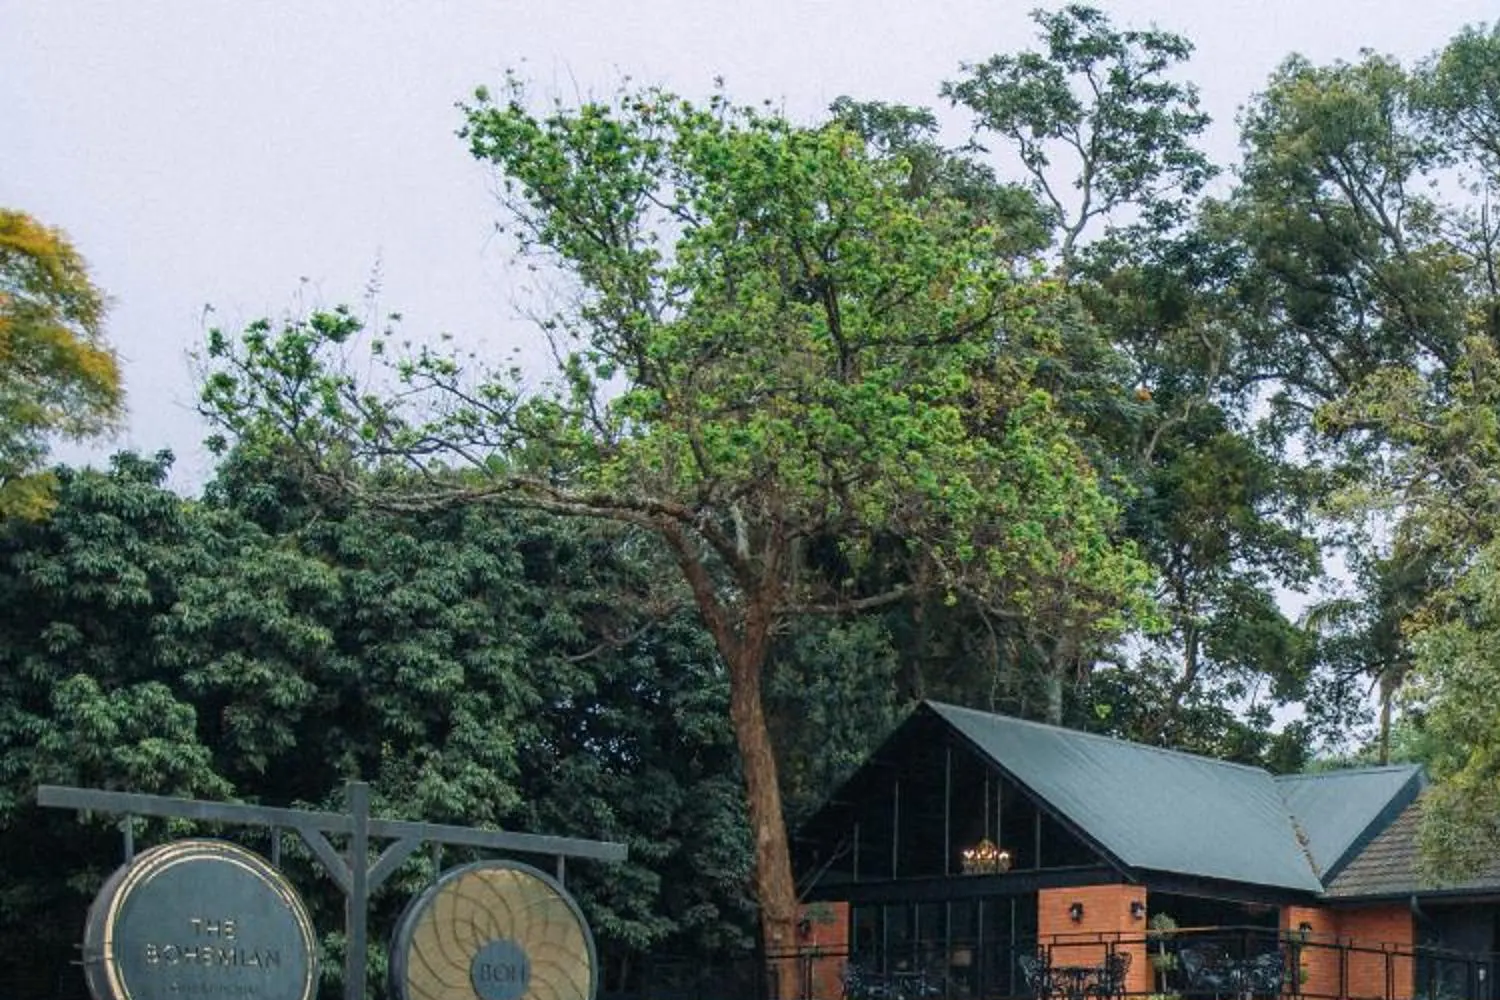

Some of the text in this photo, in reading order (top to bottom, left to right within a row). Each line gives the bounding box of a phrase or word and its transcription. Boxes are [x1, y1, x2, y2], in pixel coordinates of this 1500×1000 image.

[190, 918, 237, 940] THE
[145, 943, 281, 969] BOHEMIAN
[480, 963, 525, 984] BOH
